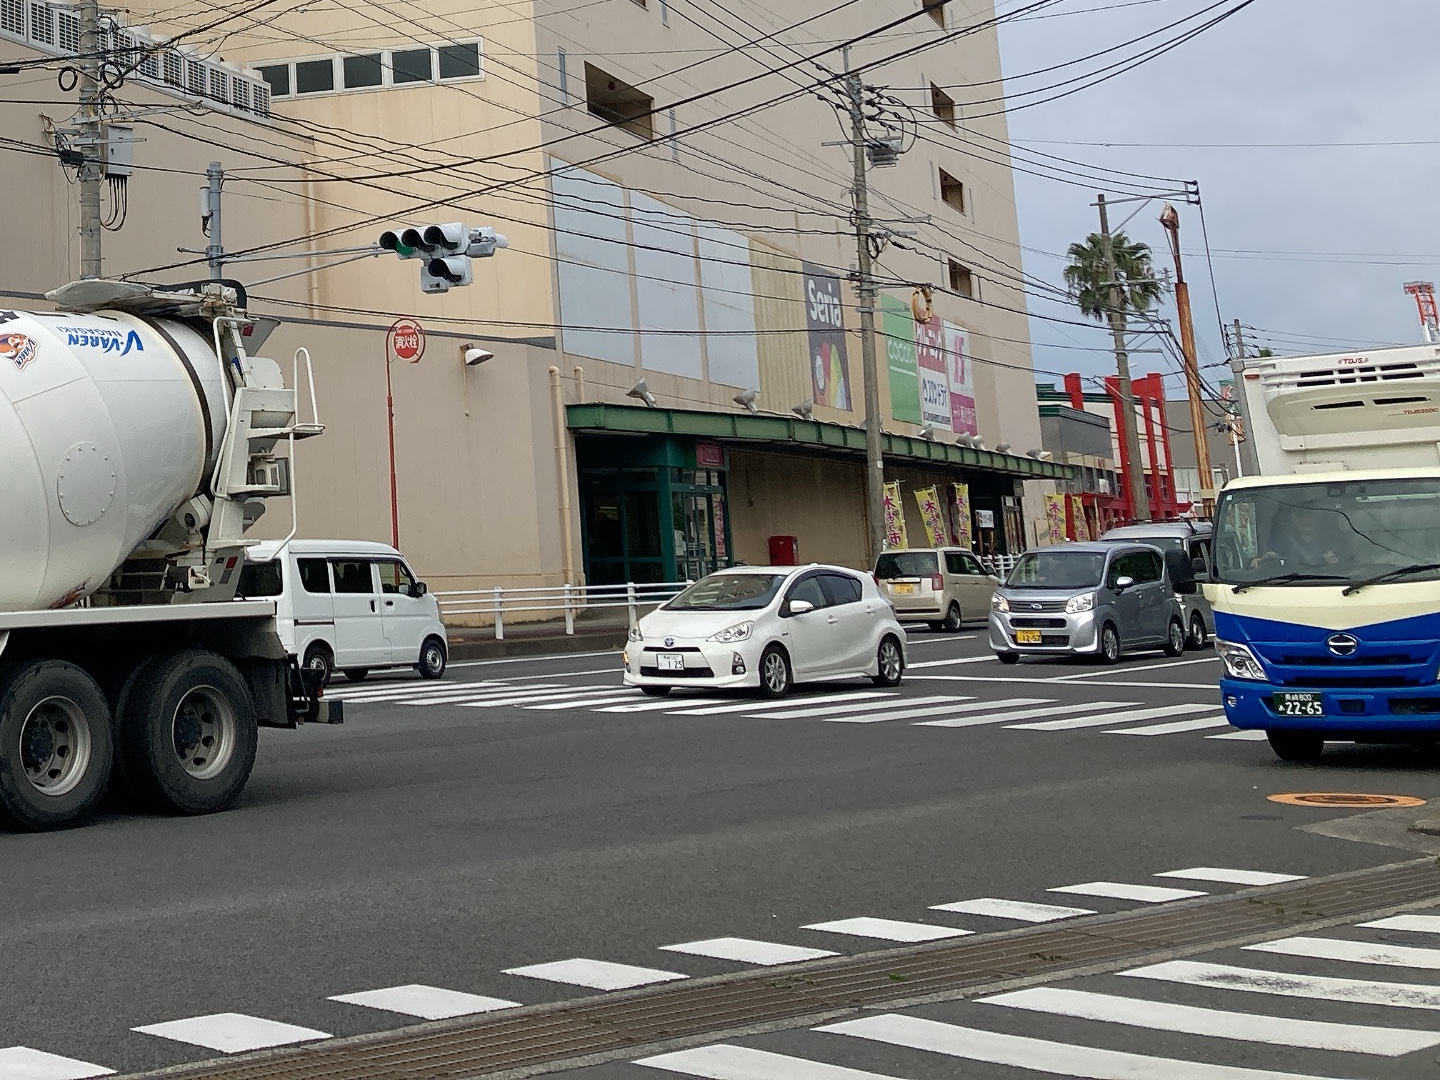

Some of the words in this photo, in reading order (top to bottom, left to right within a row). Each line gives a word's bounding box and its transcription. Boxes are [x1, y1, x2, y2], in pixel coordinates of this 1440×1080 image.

[808, 279, 842, 328] Seria
[395, 334, 418, 349] 消火栓
[1285, 701, 1323, 715] 22-65
